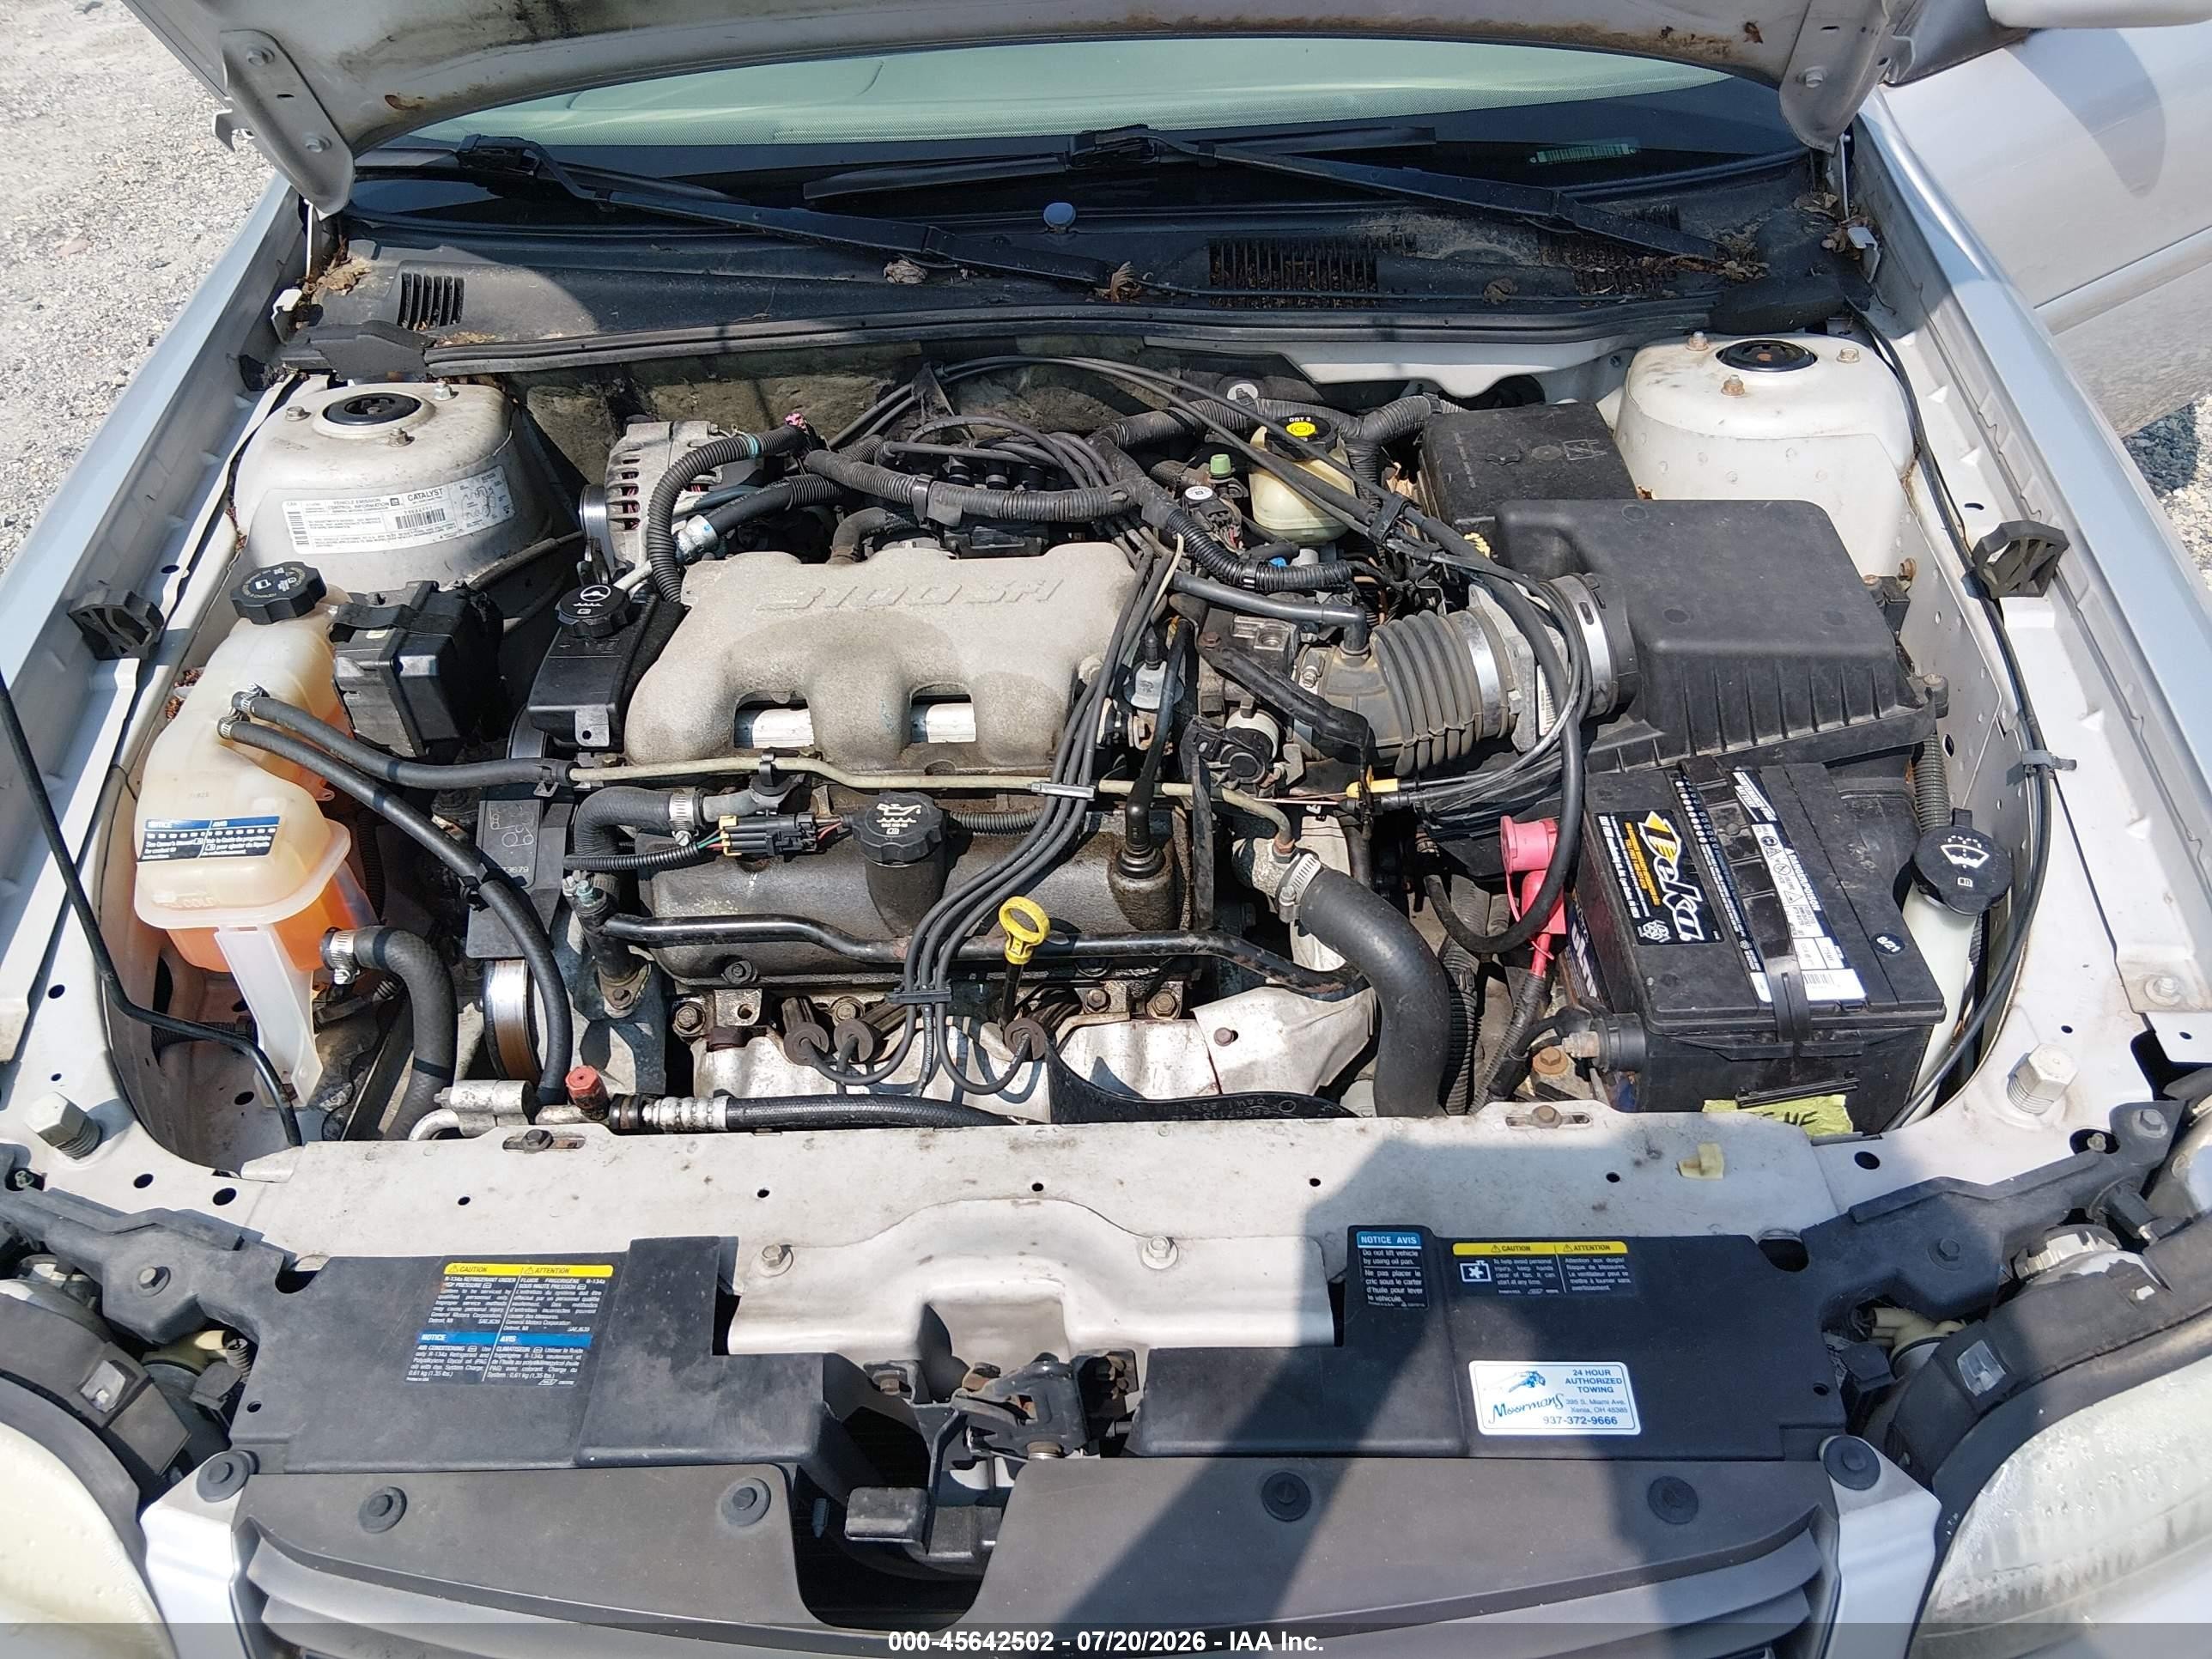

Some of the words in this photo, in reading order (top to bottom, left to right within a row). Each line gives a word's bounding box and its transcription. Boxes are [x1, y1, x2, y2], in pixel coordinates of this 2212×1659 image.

[408, 488, 443, 501] CATALYST
[1734, 785, 1761, 808] BATTERY
[1598, 816, 1611, 826] EAST
[1602, 827, 1614, 838] PENN
[1638, 811, 1705, 941] Deka
[1789, 854, 1821, 911] DANGER/POISON
[1876, 936, 1900, 952] 8/21
[924, 1033, 933, 1073] TEMPERATURE
[1488, 1393, 1565, 1425] Moormans
[1543, 1416, 1618, 1425] 937-372-9666
